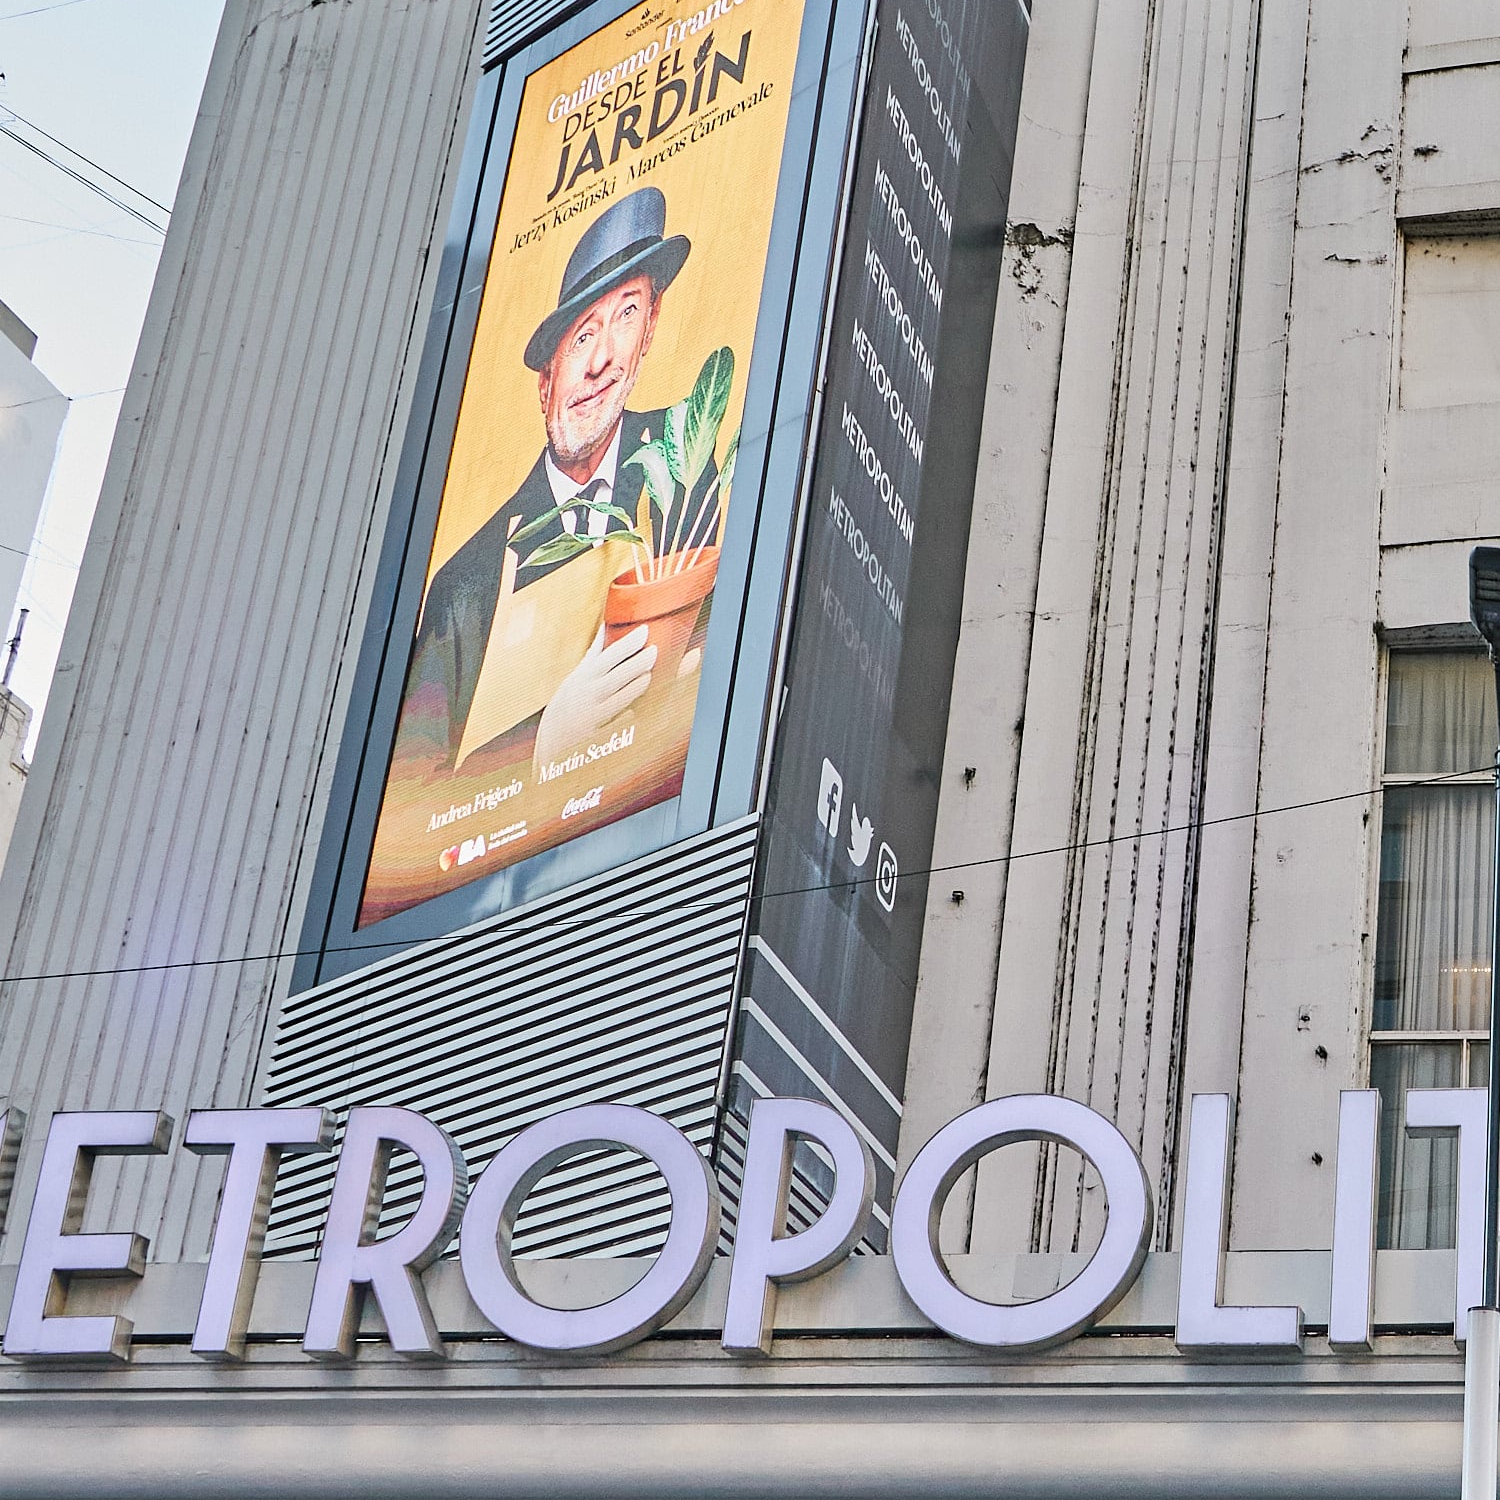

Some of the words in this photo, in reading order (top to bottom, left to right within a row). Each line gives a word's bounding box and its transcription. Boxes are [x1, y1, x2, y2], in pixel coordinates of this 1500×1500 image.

[547, 41, 659, 124] Guillermo
[563, 69, 648, 143] DESDE
[655, 47, 684, 88] EL
[896, 7, 961, 166] METROPOLITAN
[509, 220, 550, 254] Jerzy
[552, 175, 617, 229] Kosinski
[626, 137, 686, 184] Marcos
[690, 82, 773, 143] Carnevale
[874, 158, 943, 312] METROPOLITAN
[886, 83, 953, 240] METROPOLITAN
[864, 238, 934, 390] METROPOLITAN
[851, 317, 923, 466] METROPOLITAN
[841, 400, 914, 546] METROPOLITAN
[829, 484, 903, 626] METROPOLITAN
[426, 803, 473, 833] Andrea
[472, 778, 523, 813] Frigerio
[537, 751, 586, 785] Martín
[584, 725, 635, 762] Seefeld
